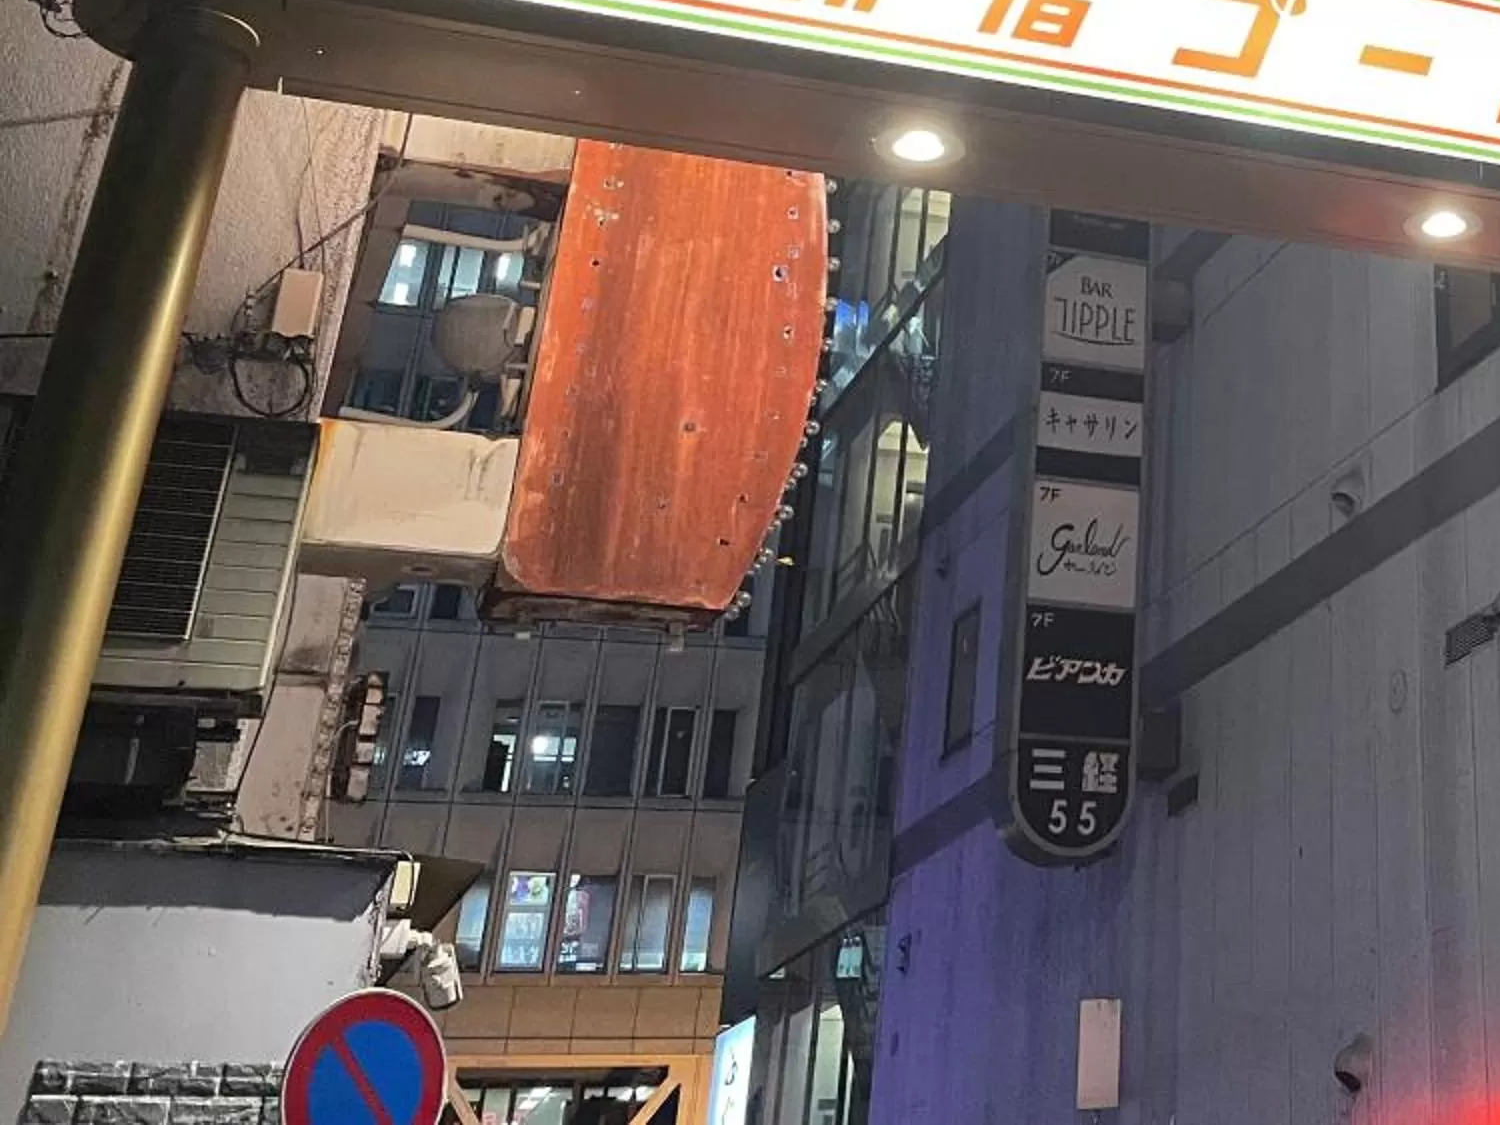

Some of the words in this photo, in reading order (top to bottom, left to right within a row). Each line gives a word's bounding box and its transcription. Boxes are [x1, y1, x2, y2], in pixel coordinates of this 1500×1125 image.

[1080, 274, 1114, 299] BAR
[1053, 297, 1136, 343] TIPPLE
[1045, 406, 1138, 443] キャサリン
[1039, 486, 1062, 503] 7F
[1031, 612, 1056, 628] 7F
[1048, 798, 1098, 837] 55
